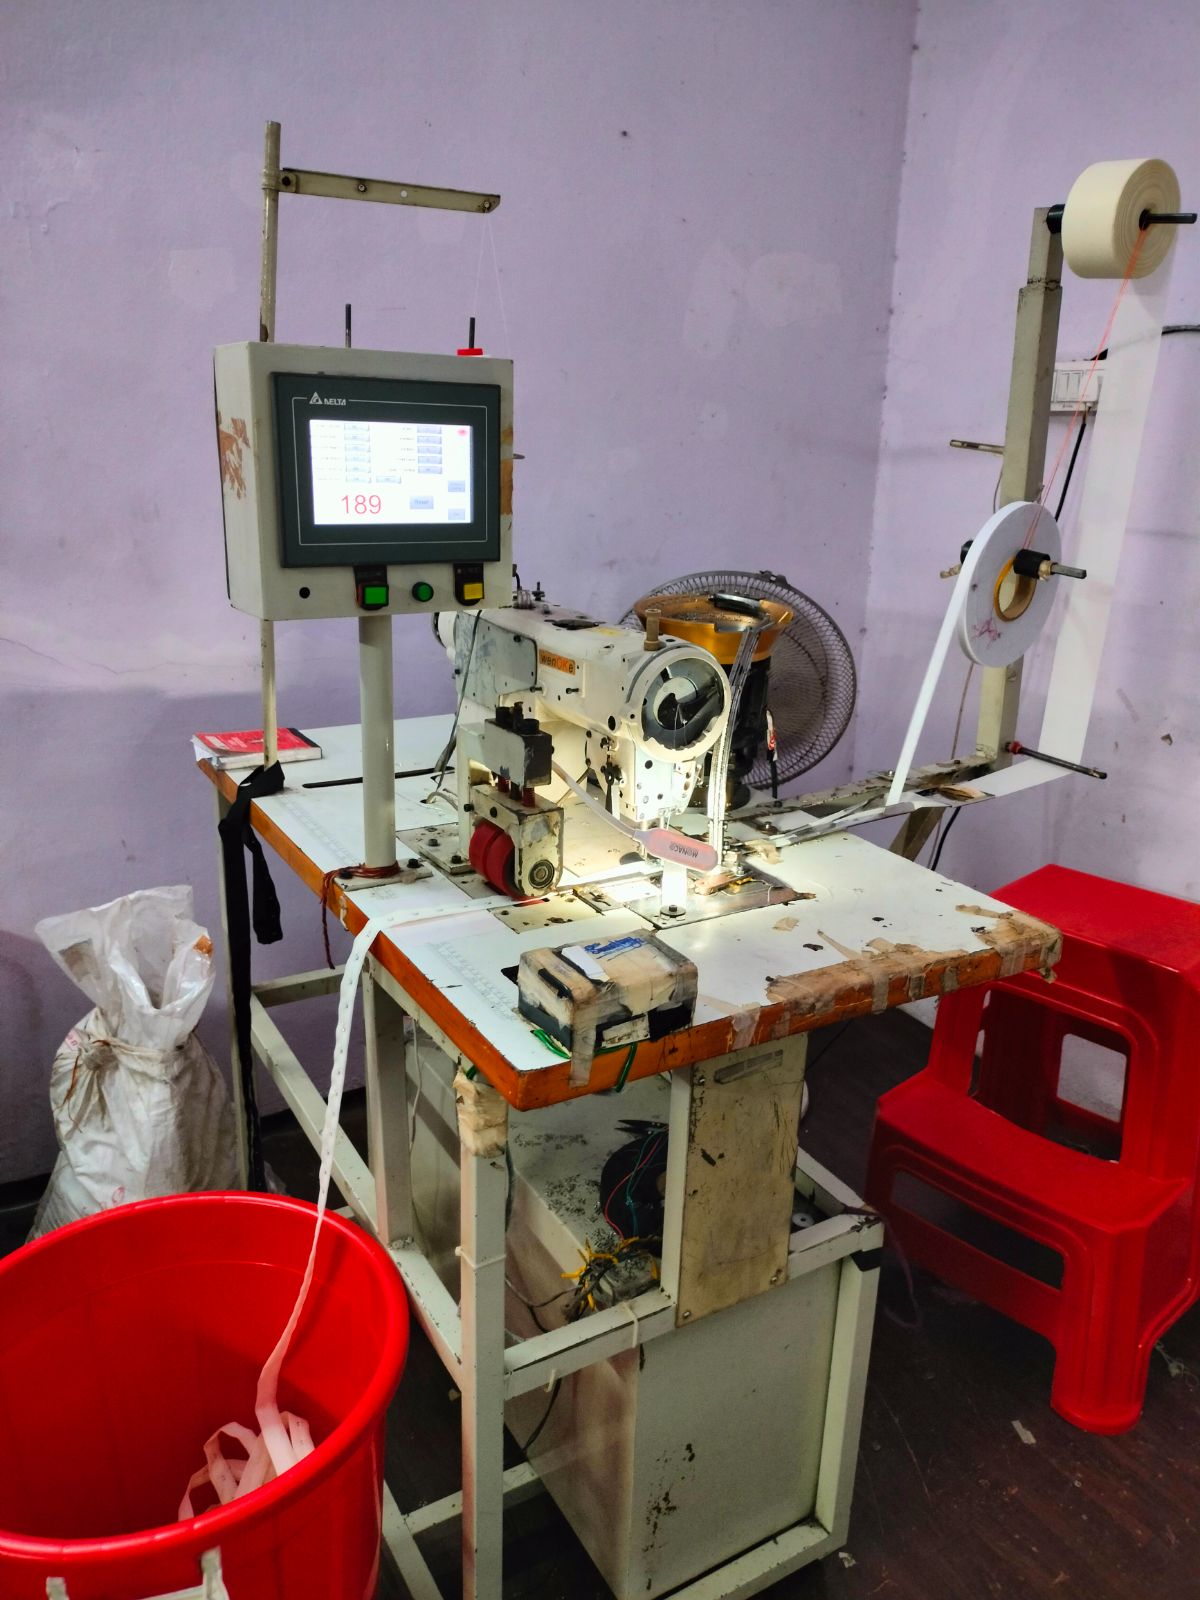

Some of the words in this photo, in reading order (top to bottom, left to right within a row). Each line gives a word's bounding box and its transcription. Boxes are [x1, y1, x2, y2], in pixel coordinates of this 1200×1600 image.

[323, 397, 346, 406] DELTA
[341, 494, 382, 514] 189
[668, 841, 699, 859] MONACO
